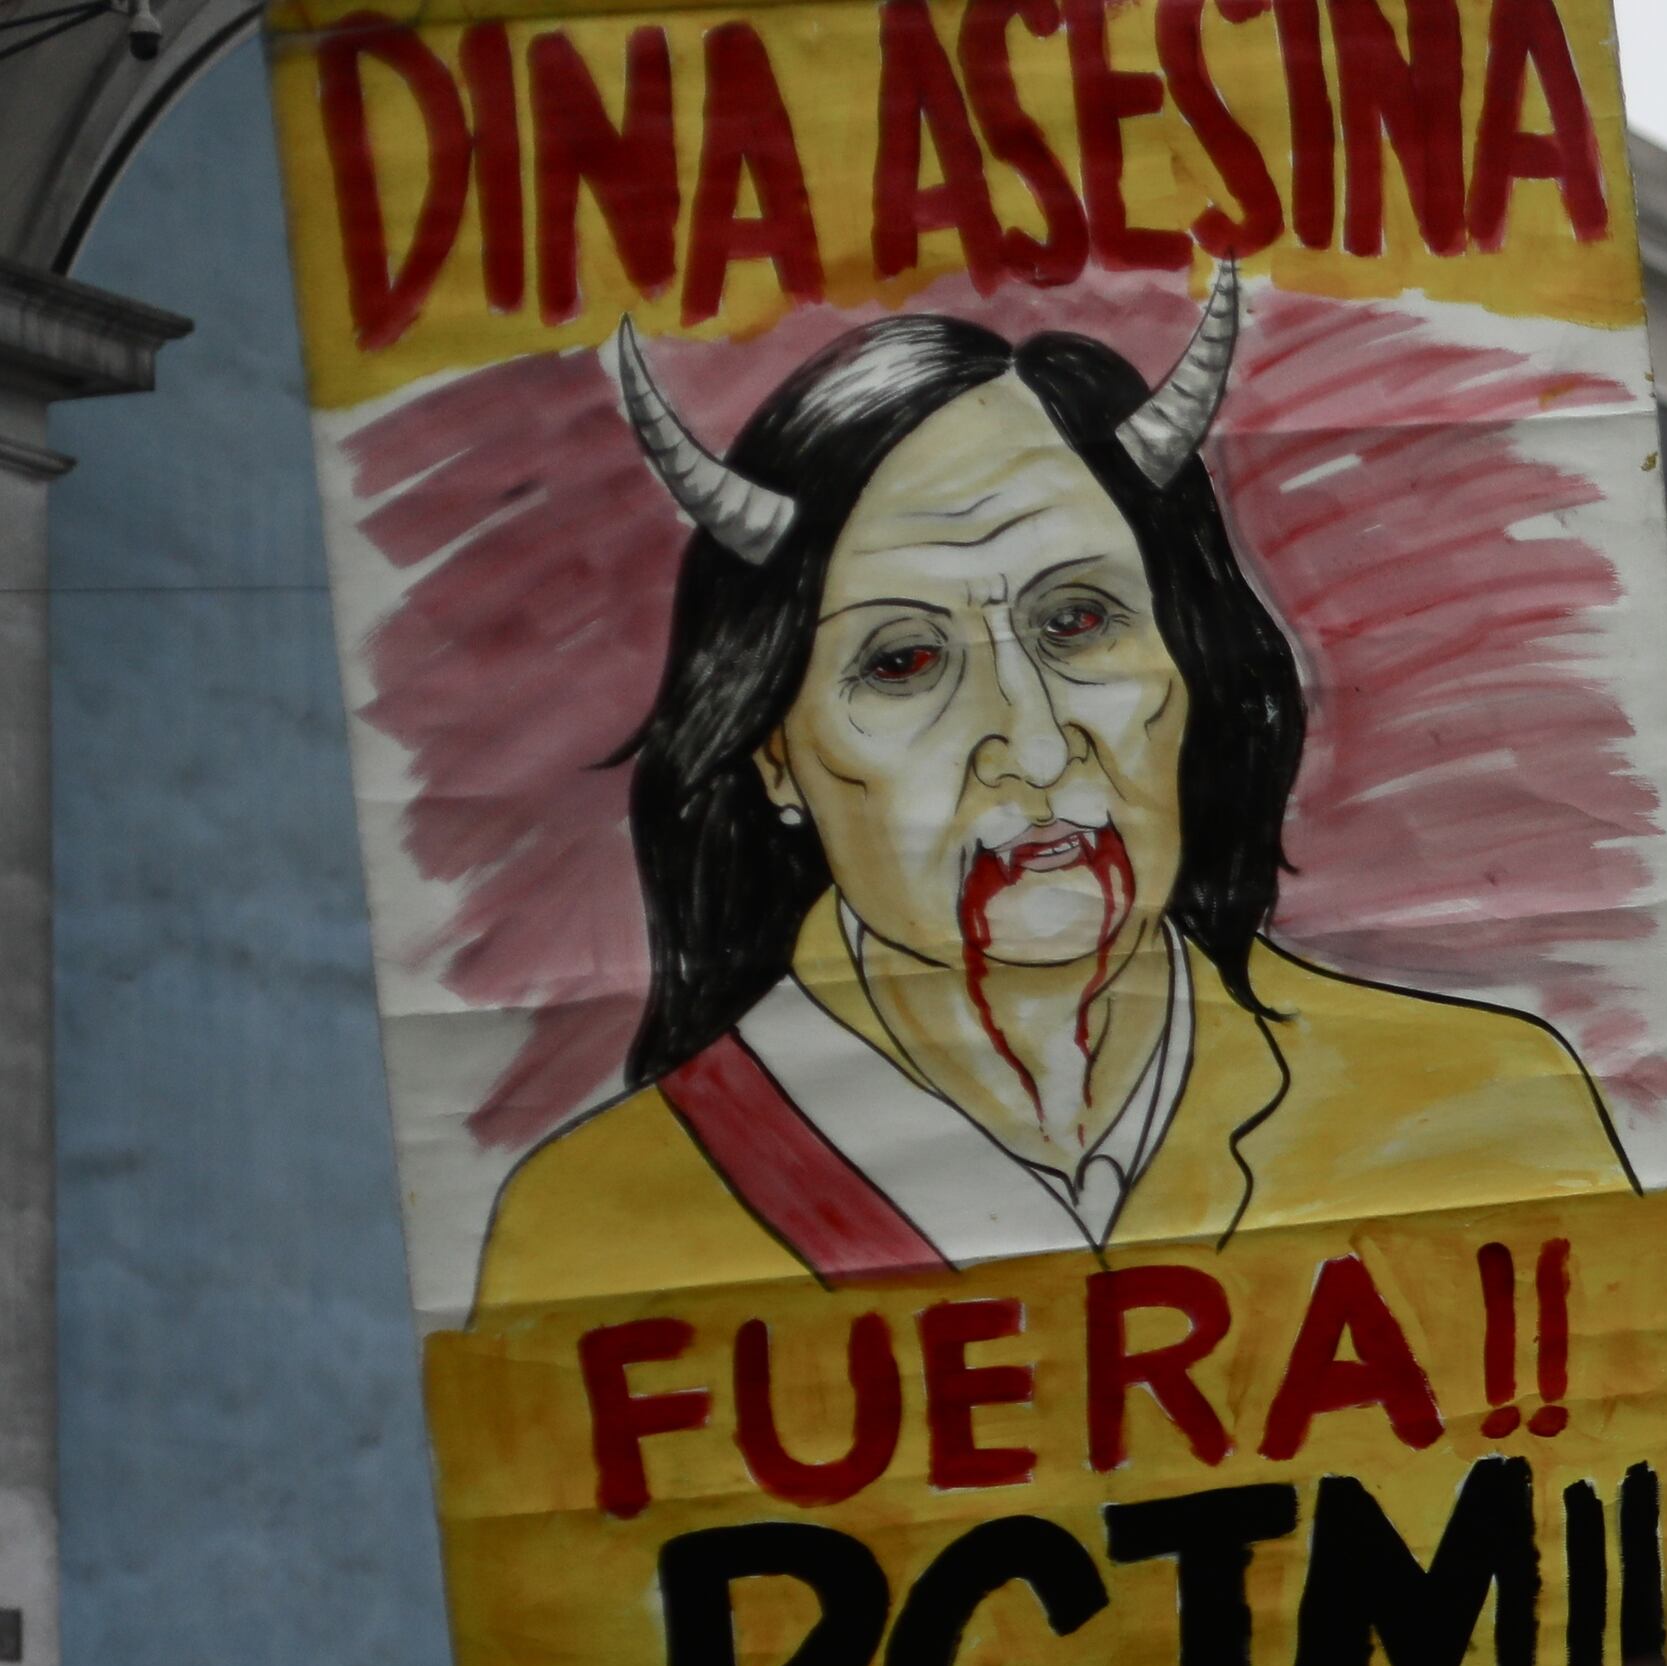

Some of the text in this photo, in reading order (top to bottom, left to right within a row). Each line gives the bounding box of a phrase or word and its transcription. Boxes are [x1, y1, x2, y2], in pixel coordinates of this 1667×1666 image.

[319, 0, 1609, 350] DINA ASESINA
[578, 1238, 1572, 1518] FUERA!!
